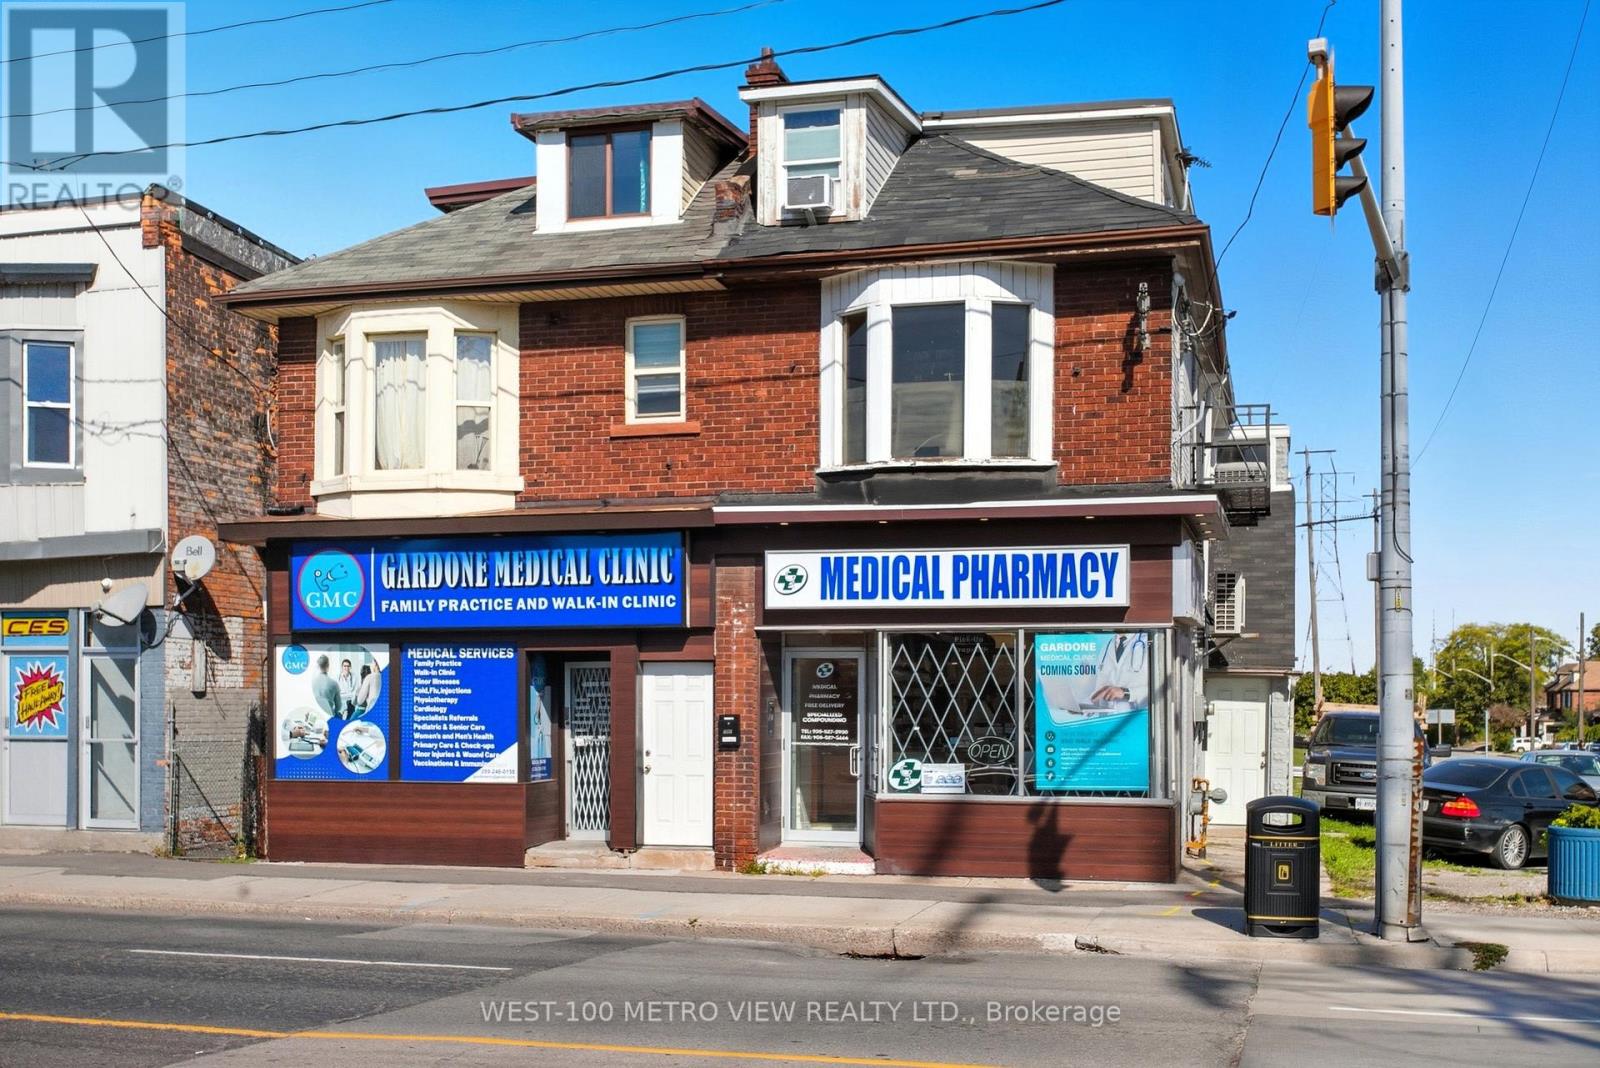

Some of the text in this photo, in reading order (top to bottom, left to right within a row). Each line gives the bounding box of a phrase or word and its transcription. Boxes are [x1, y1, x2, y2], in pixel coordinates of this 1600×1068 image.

[186, 546, 202, 556] Bell
[381, 547, 673, 590] GARDONE MEDICAL CLINIC
[820, 552, 1119, 600] MEDICAL PHARMACY
[305, 591, 358, 609] GMC
[381, 595, 676, 613] FAMILY PRACTICE AND WALK-IN CLINIC
[7, 620, 66, 634] CES
[1040, 642, 1096, 652] GARDONE
[408, 648, 514, 659] MEDICAL SERVICES
[1073, 653, 1096, 661] CLINIC
[285, 662, 306, 670] GMC
[414, 660, 434, 668] Family
[1040, 665, 1096, 676] COMING SOON
[24, 683, 48, 699] FREE
[414, 696, 458, 705] Physiotherapy
[414, 705, 447, 714] Cardiology
[413, 742, 437, 750] Primary
[461, 742, 495, 750] Check-ups
[432, 751, 455, 759] Injuries
[971, 744, 1009, 760] OPEN
